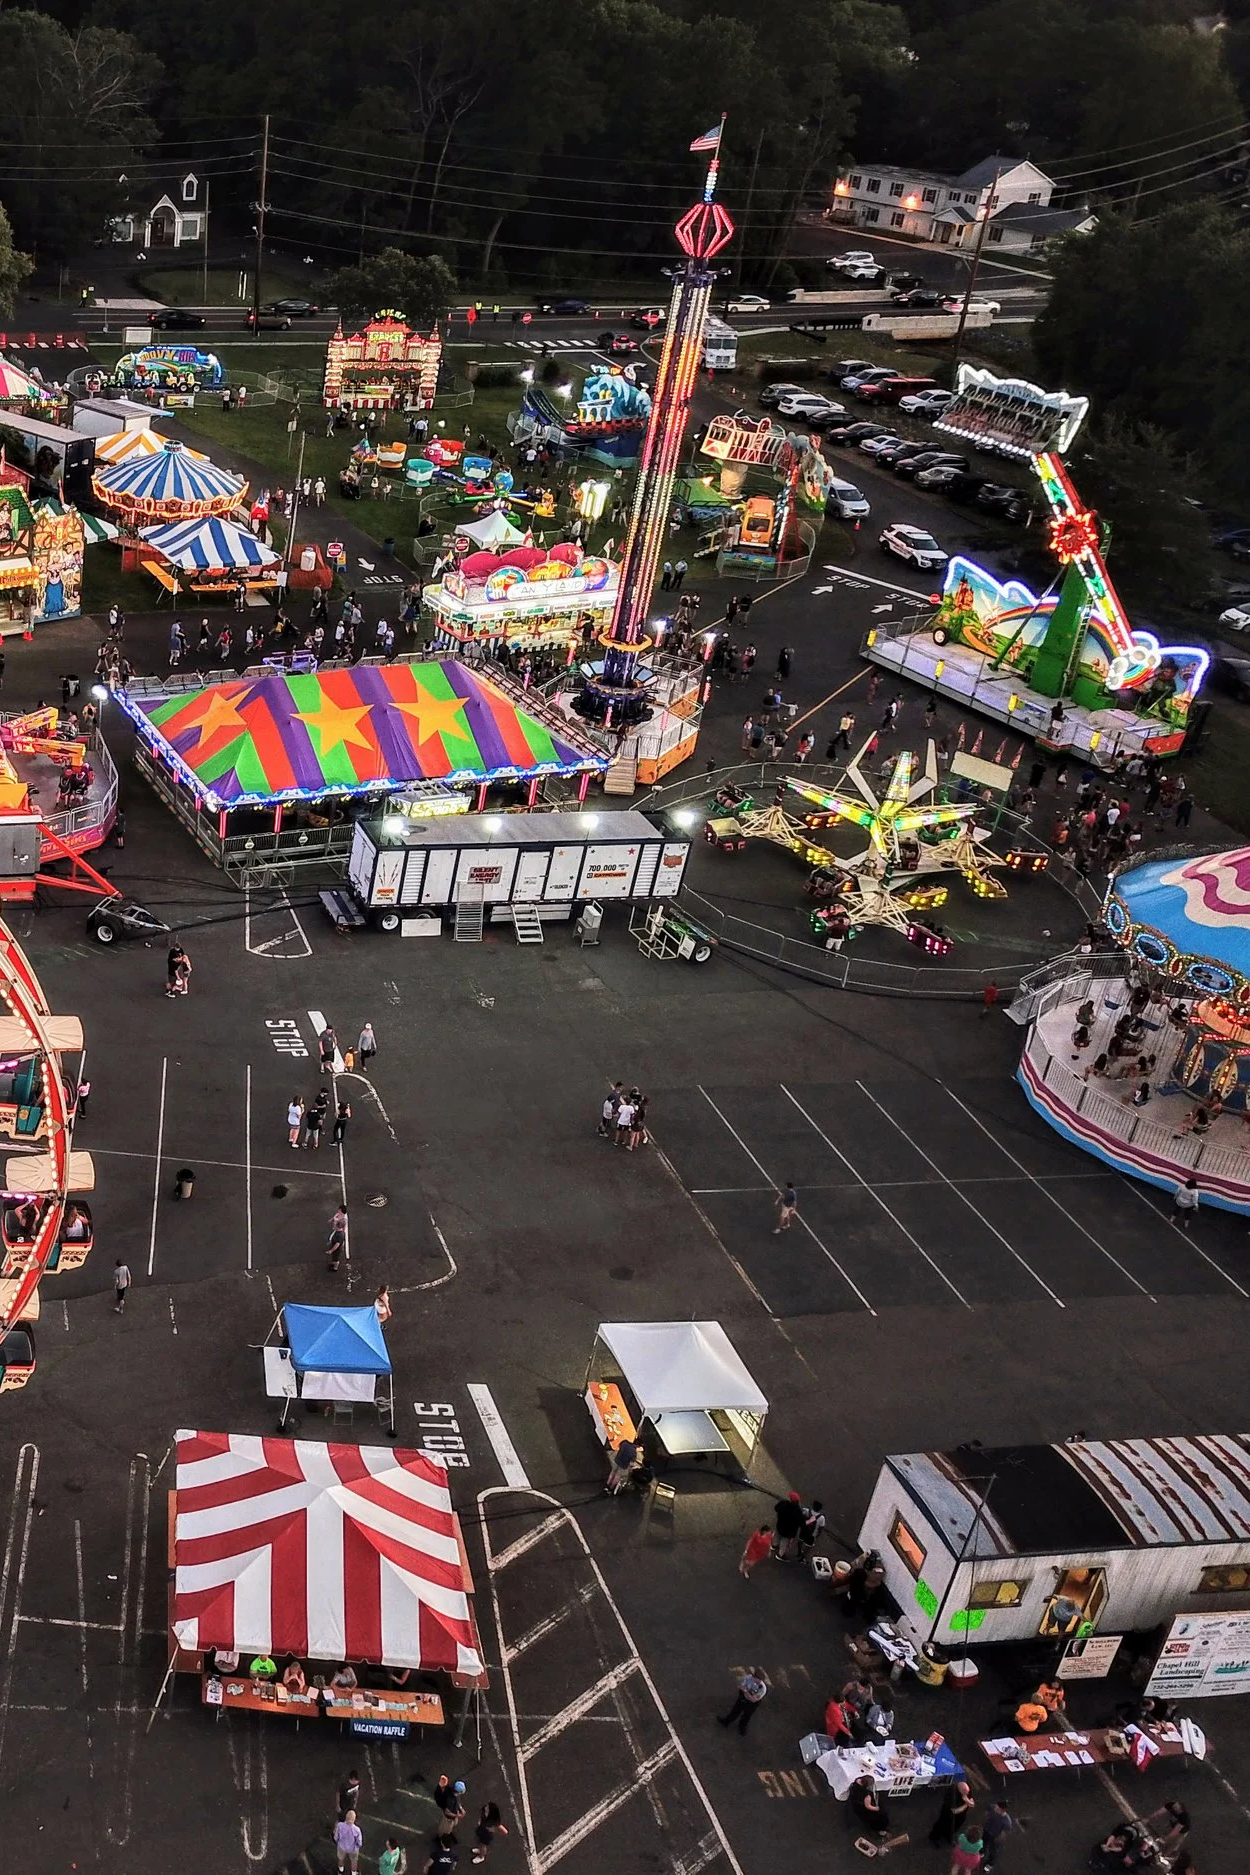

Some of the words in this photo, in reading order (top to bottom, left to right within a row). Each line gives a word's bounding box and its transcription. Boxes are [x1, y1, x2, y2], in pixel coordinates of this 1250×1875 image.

[826, 574, 871, 590] STOP
[885, 593, 931, 609] STOP
[264, 1019, 310, 1057] STOP
[413, 1402, 470, 1467] STOP
[1156, 1660, 1182, 1669] Chapel
[1184, 1660, 1200, 1668] Hill
[353, 1722, 383, 1735] VACATION
[383, 1725, 406, 1737] RAFFLE
[893, 1775, 915, 1787] LIFE
